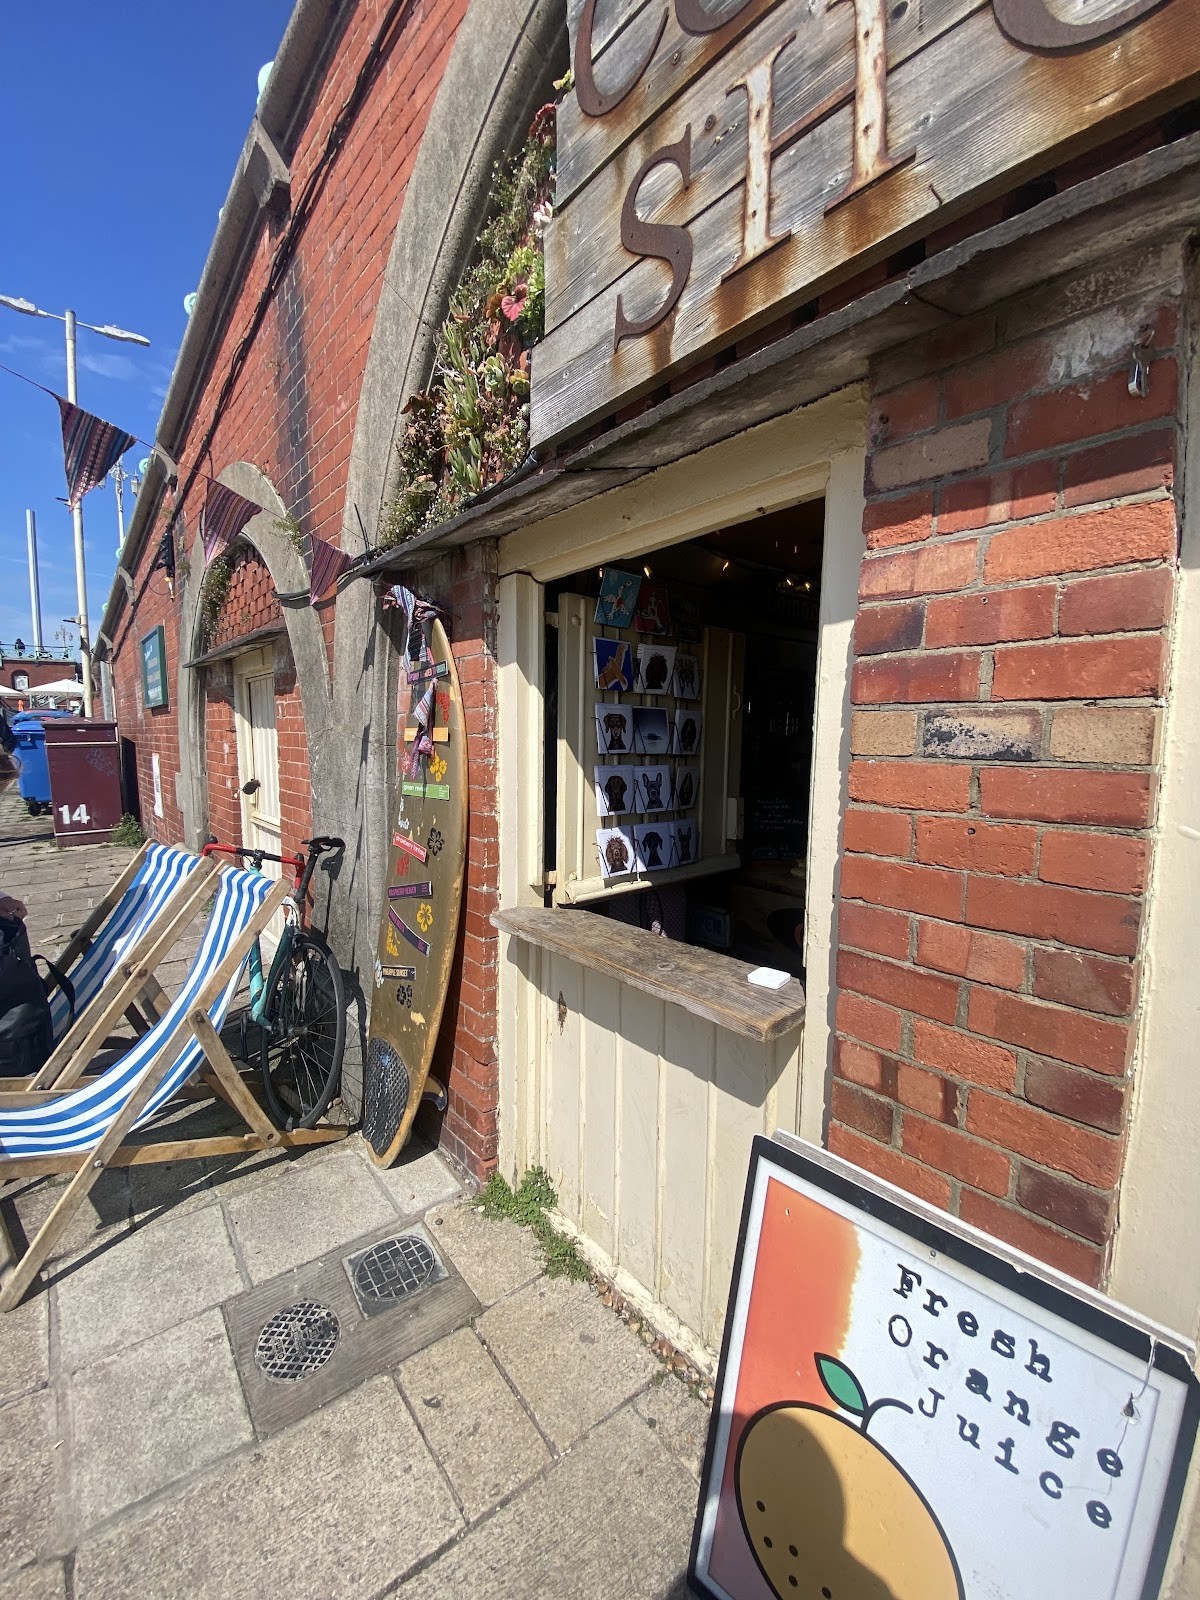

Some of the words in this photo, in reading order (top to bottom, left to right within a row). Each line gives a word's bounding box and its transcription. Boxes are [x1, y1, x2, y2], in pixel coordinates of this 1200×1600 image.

[613, 0, 1176, 353] SH
[58, 803, 91, 826] 14
[893, 1263, 1052, 1383] Fresh
[888, 1314, 1124, 1478] Orange
[917, 1387, 1113, 1528] Juice
